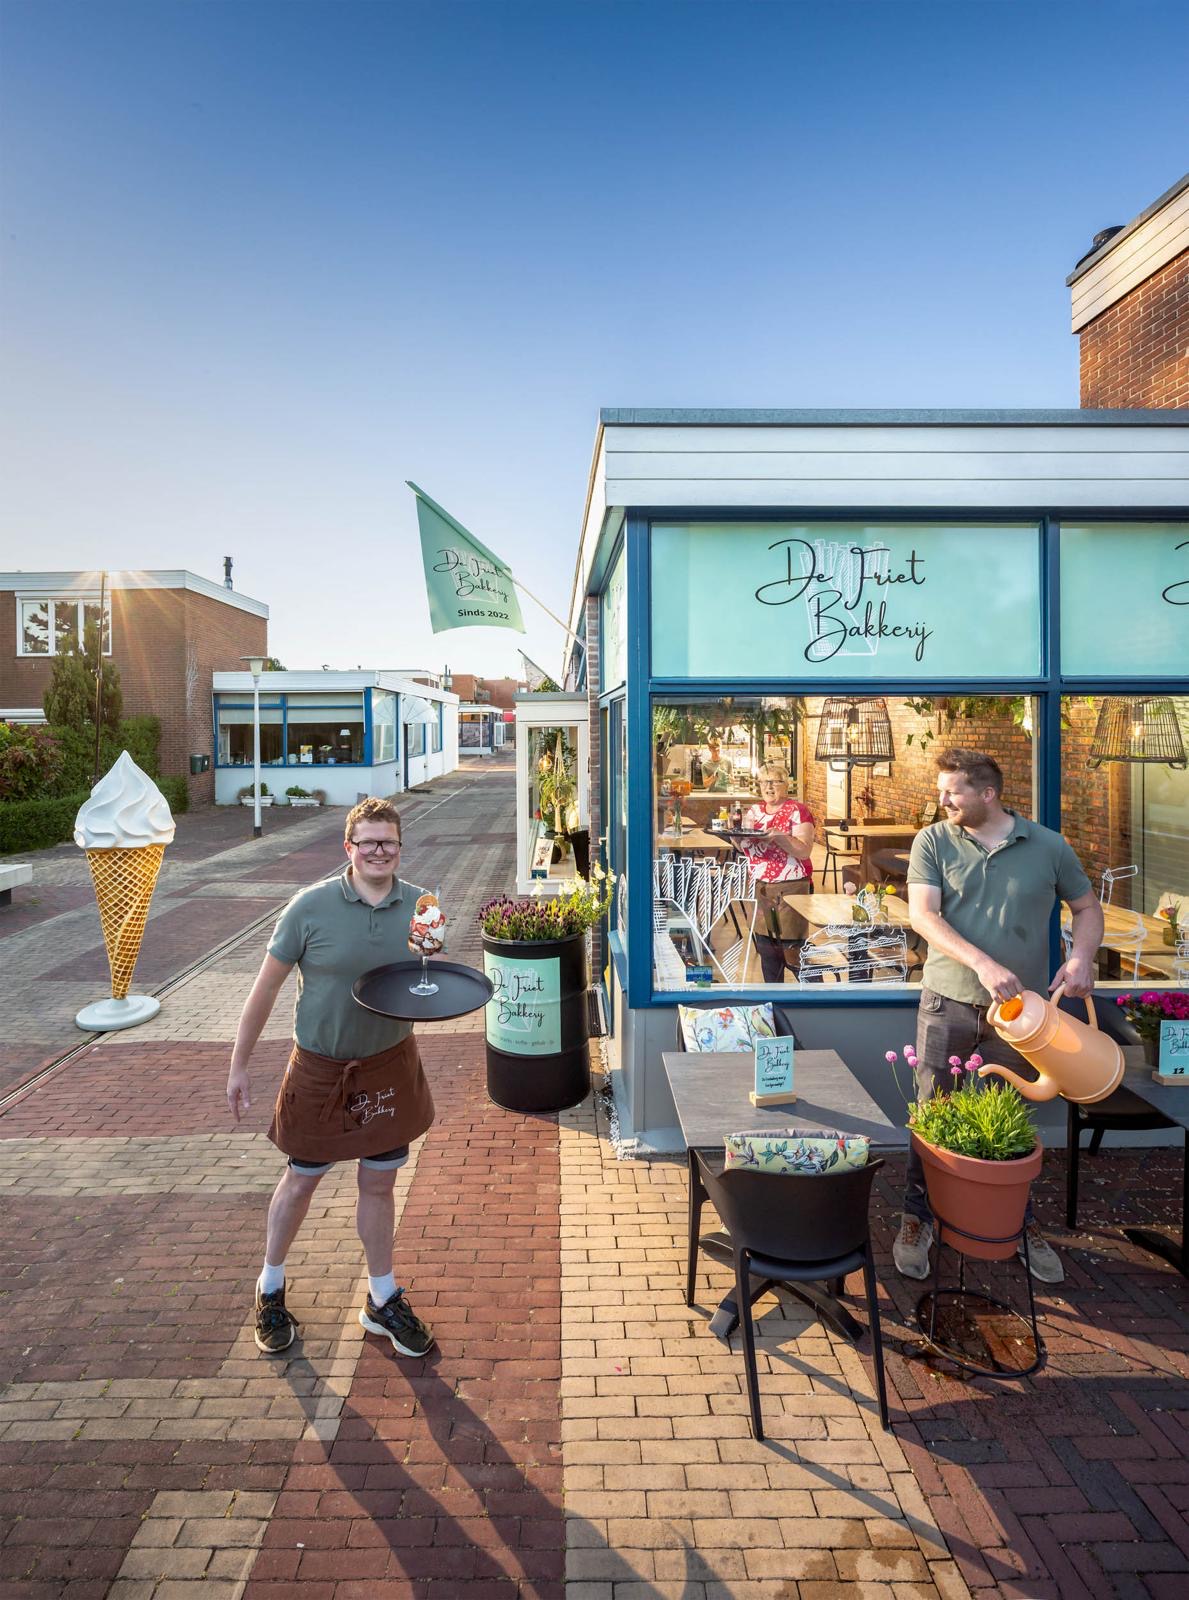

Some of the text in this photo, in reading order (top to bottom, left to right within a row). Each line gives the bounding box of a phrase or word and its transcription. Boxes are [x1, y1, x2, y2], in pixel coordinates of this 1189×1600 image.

[433, 549, 467, 573] De
[755, 538, 926, 611] De Friet
[457, 609, 510, 620] Sinds 2022
[804, 589, 934, 663] Bakkerij
[489, 967, 545, 1002] De Friet
[1172, 1067, 1185, 1075] 12
